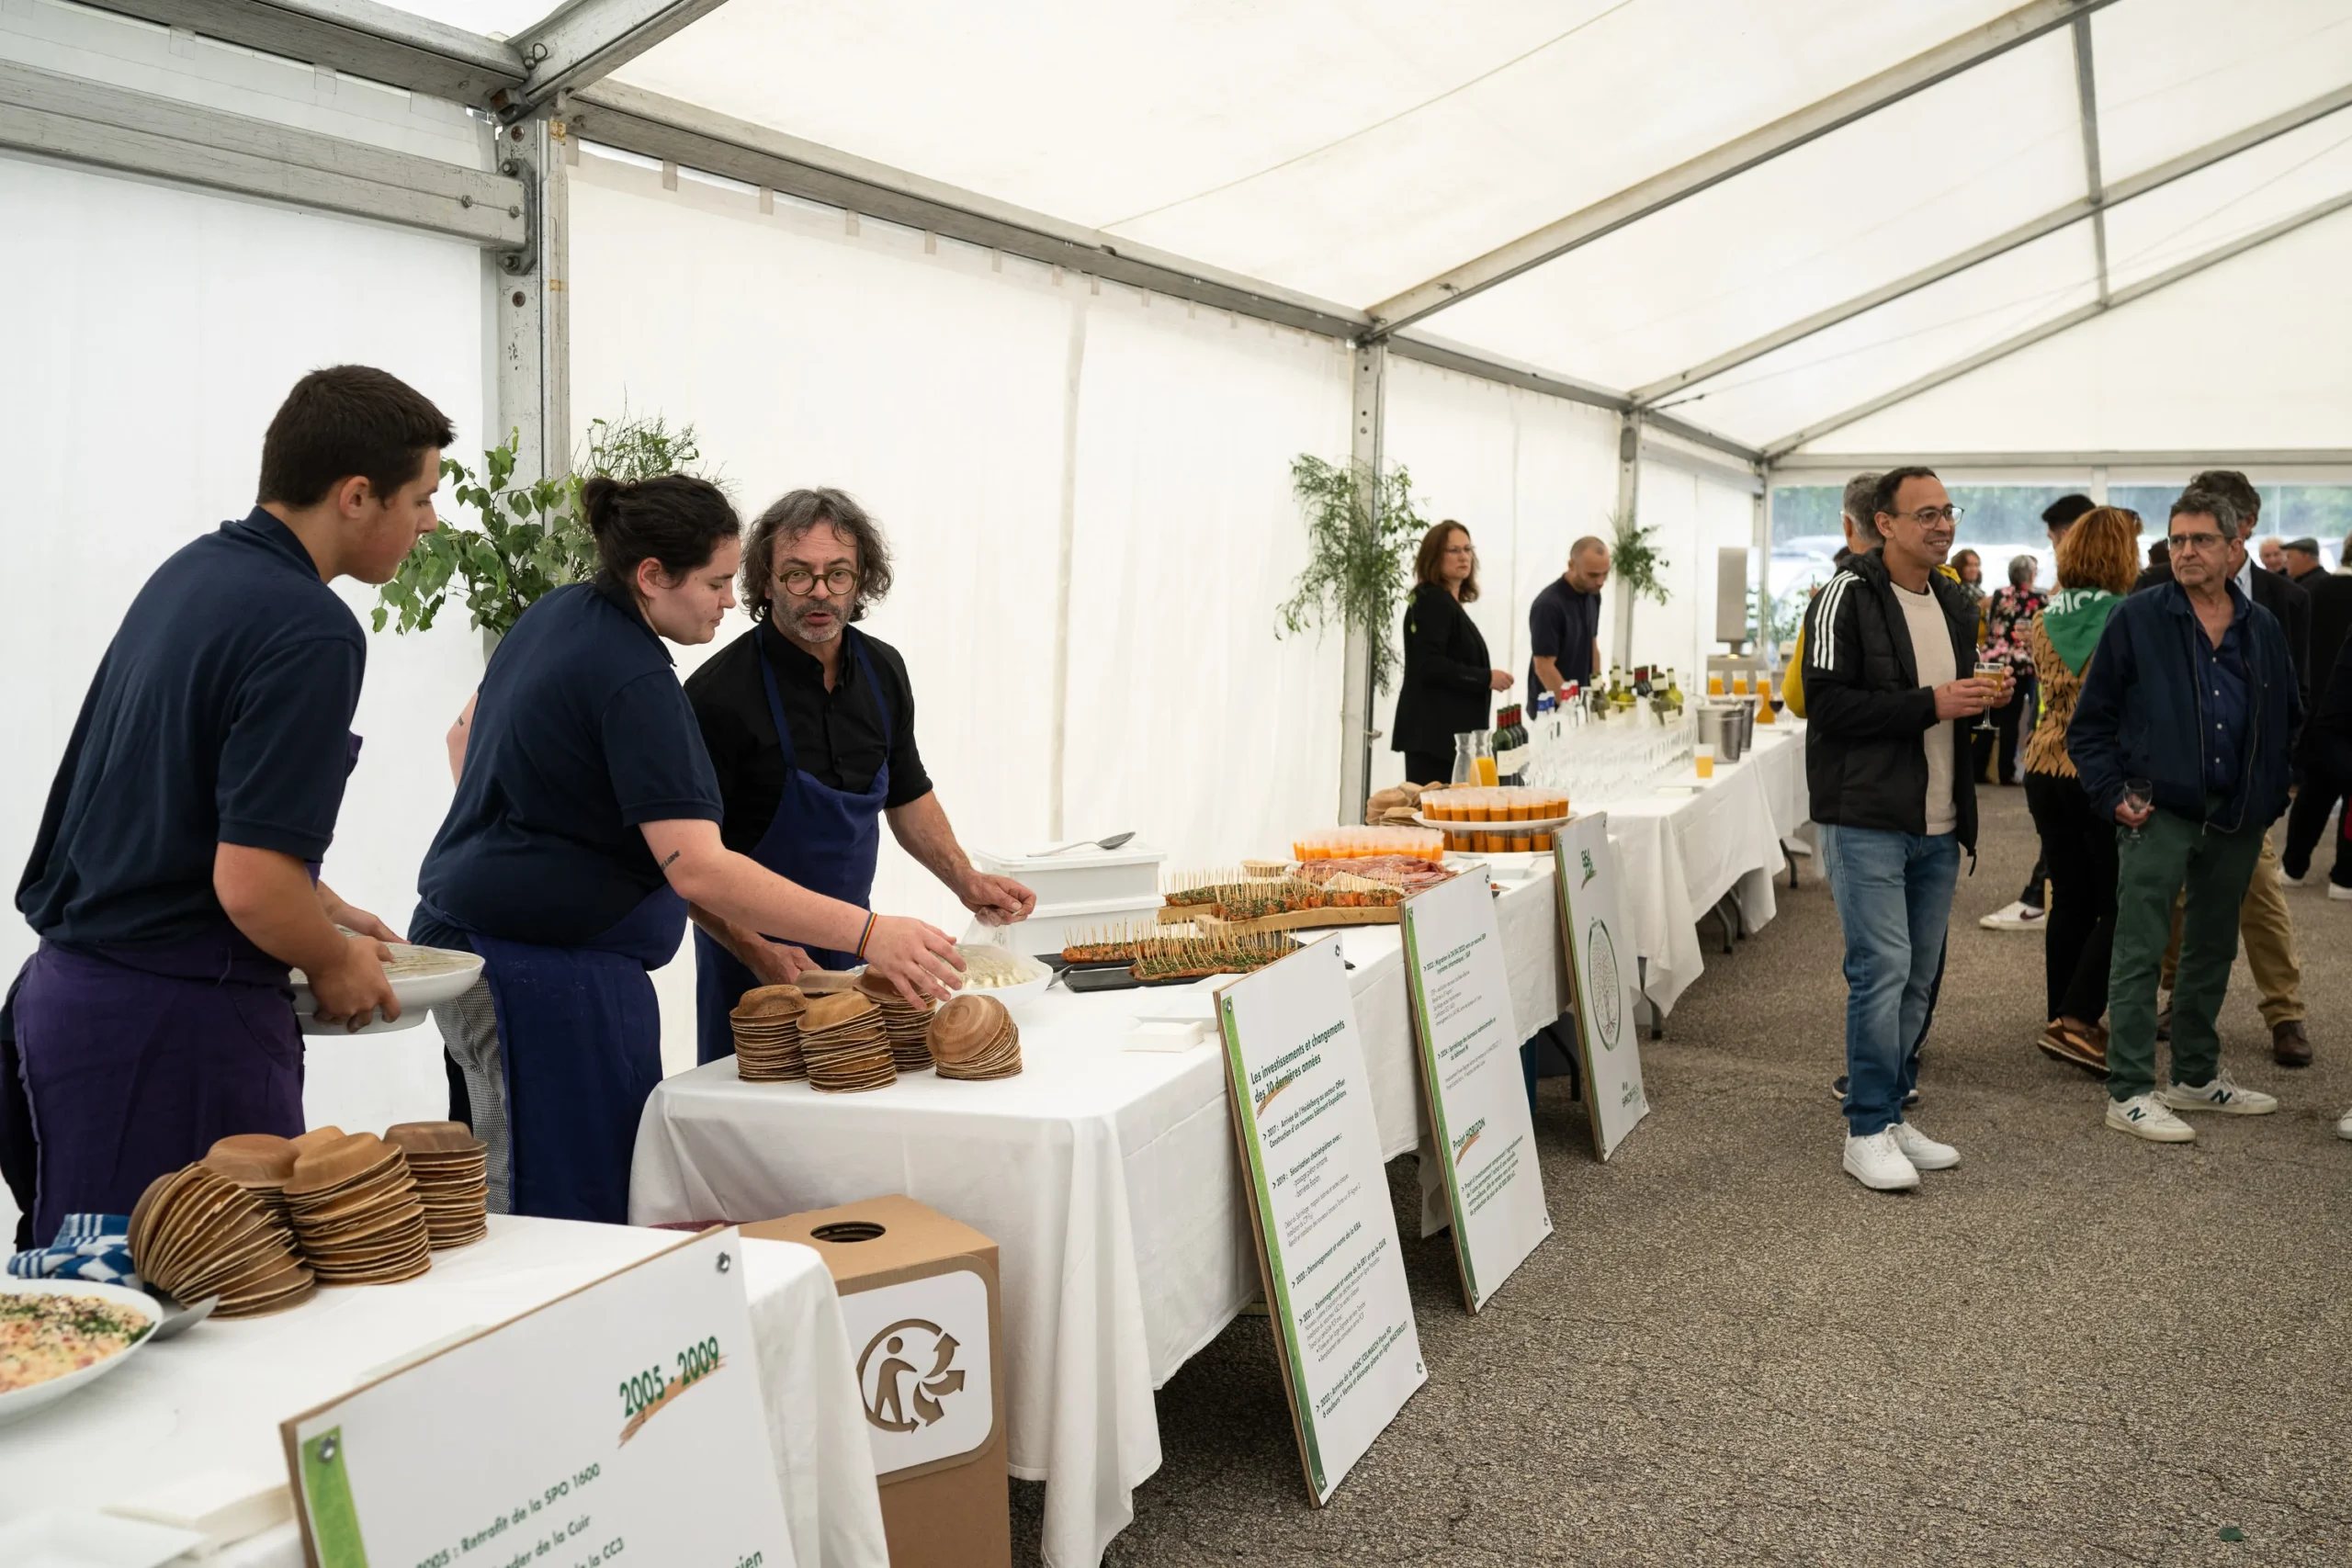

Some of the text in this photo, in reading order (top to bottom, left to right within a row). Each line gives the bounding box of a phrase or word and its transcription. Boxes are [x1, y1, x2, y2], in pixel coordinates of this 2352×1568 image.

[1250, 1021, 1345, 1085] Les investissements et changements
[1255, 1055, 1320, 1103] des 10 dernières années
[2210, 1089, 2233, 1105] N
[1267, 1125, 1276, 1137] 2017
[1281, 1114, 1294, 1128] Arrivée
[1295, 1111, 1299, 1119] de
[1324, 1086, 1335, 1098] secteur
[1270, 1130, 1291, 1148] Construction
[1299, 1113, 1314, 1127] nouveau
[1453, 1117, 1486, 1151] Projet HORIZON
[2127, 1106, 2147, 1122] N
[1276, 1174, 1285, 1187] 2019
[1290, 1156, 1310, 1177] Sécurisation
[1295, 1270, 1306, 1284] 2020
[1307, 1247, 1333, 1274] Déménagement
[1337, 1236, 1346, 1247] vente
[1303, 1309, 1312, 1322] 2021
[1315, 1282, 1340, 1311] Déménagement
[1344, 1271, 1352, 1282] vente
[1352, 1266, 1357, 1274] de
[619, 1365, 665, 1418] 2005
[677, 1336, 719, 1386] 2009
[1320, 1393, 1330, 1407] 2022
[1332, 1380, 1344, 1395] Arrivée
[1344, 1373, 1349, 1382] de
[1327, 1397, 1340, 1415] couleurs
[1342, 1382, 1353, 1395] Vernis
[1352, 1377, 1356, 1385] et
[1357, 1364, 1370, 1381] découpe
[1370, 1354, 1379, 1369] plane
[1382, 1341, 1390, 1352] ligne
[415, 1546, 450, 1568] 005
[460, 1517, 508, 1553] Retrofit
[512, 1507, 527, 1526] de
[528, 1498, 542, 1515] la
[544, 1481, 570, 1506] SPO
[572, 1462, 602, 1489] 1600
[535, 1540, 550, 1557] de
[552, 1530, 566, 1546] la
[567, 1514, 592, 1537] Cuir
[588, 1537, 625, 1568] la CC3
